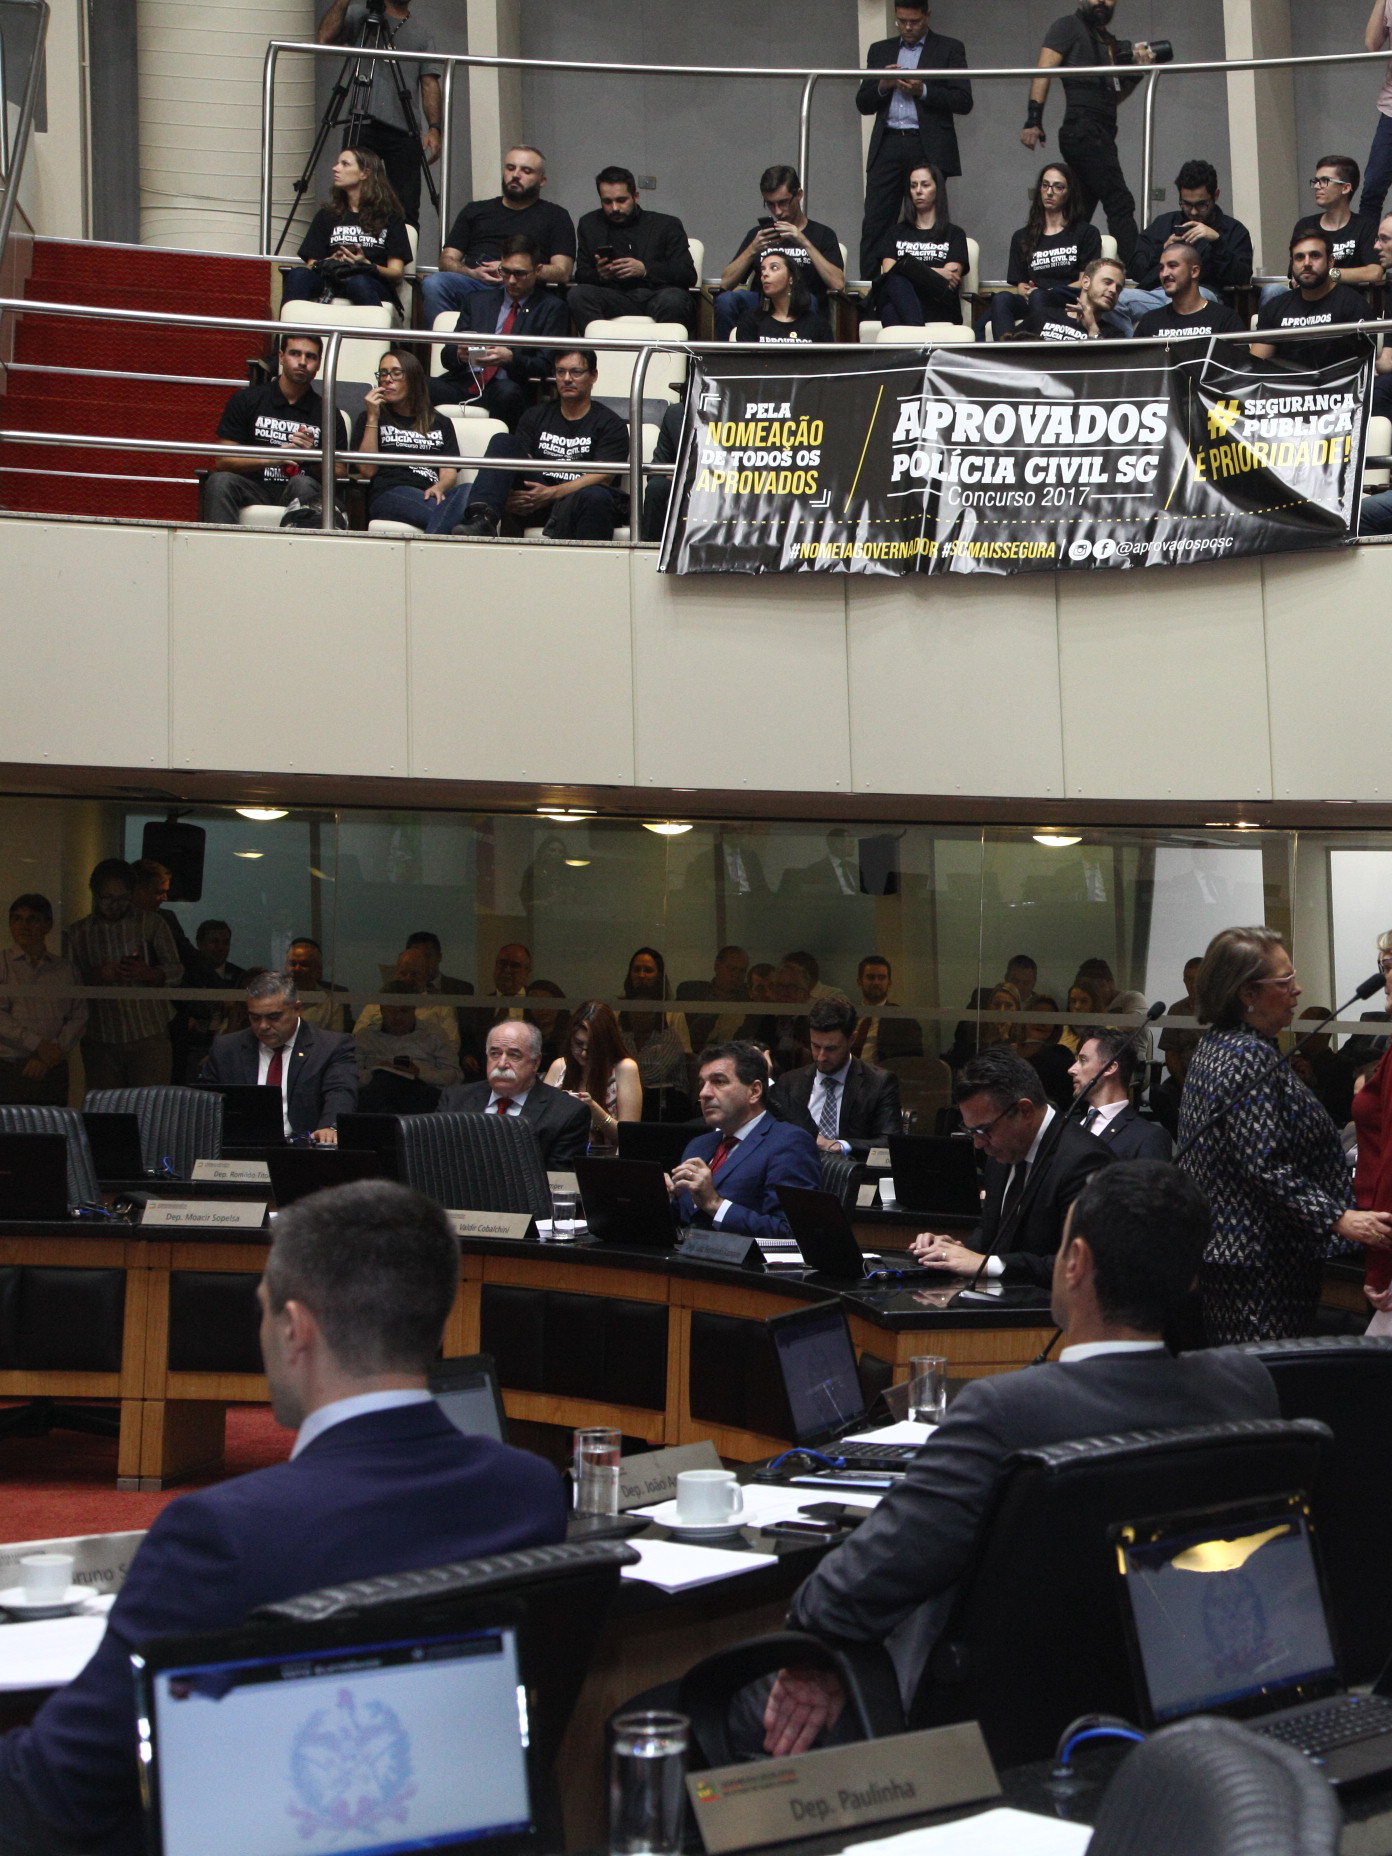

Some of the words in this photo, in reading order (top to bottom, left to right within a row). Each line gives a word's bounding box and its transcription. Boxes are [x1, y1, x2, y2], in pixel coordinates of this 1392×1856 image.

[1281, 313, 1331, 327] APROVADOS
[1043, 322, 1088, 340] APROVADO
[1158, 327, 1212, 337] APROVADOS
[745, 403, 791, 418] PELA
[1244, 393, 1355, 417] SEGURANÇA
[892, 400, 1168, 444] APROVADOS
[705, 416, 824, 450] NOMEAÇÃO
[701, 451, 727, 465] DE
[730, 451, 793, 467] TODOS
[795, 450, 821, 466] OS
[891, 449, 1016, 484] POLÍCIA
[1024, 457, 1109, 484] CIVIL
[1115, 455, 1160, 483] SC
[1211, 435, 1352, 481] PRIORIDADE!
[696, 470, 818, 494] APROVADOS
[948, 486, 1036, 507] Concurso
[1041, 487, 1090, 506] 2017
[790, 538, 938, 560] #NOMEIAGOVERNADOR
[185, 1213, 210, 1221] Moacir
[212, 1214, 240, 1223] Sopelsa
[73, 1569, 113, 1584] runo
[789, 1798, 835, 1822] Dep.
[838, 1779, 916, 1810] Paulinha
